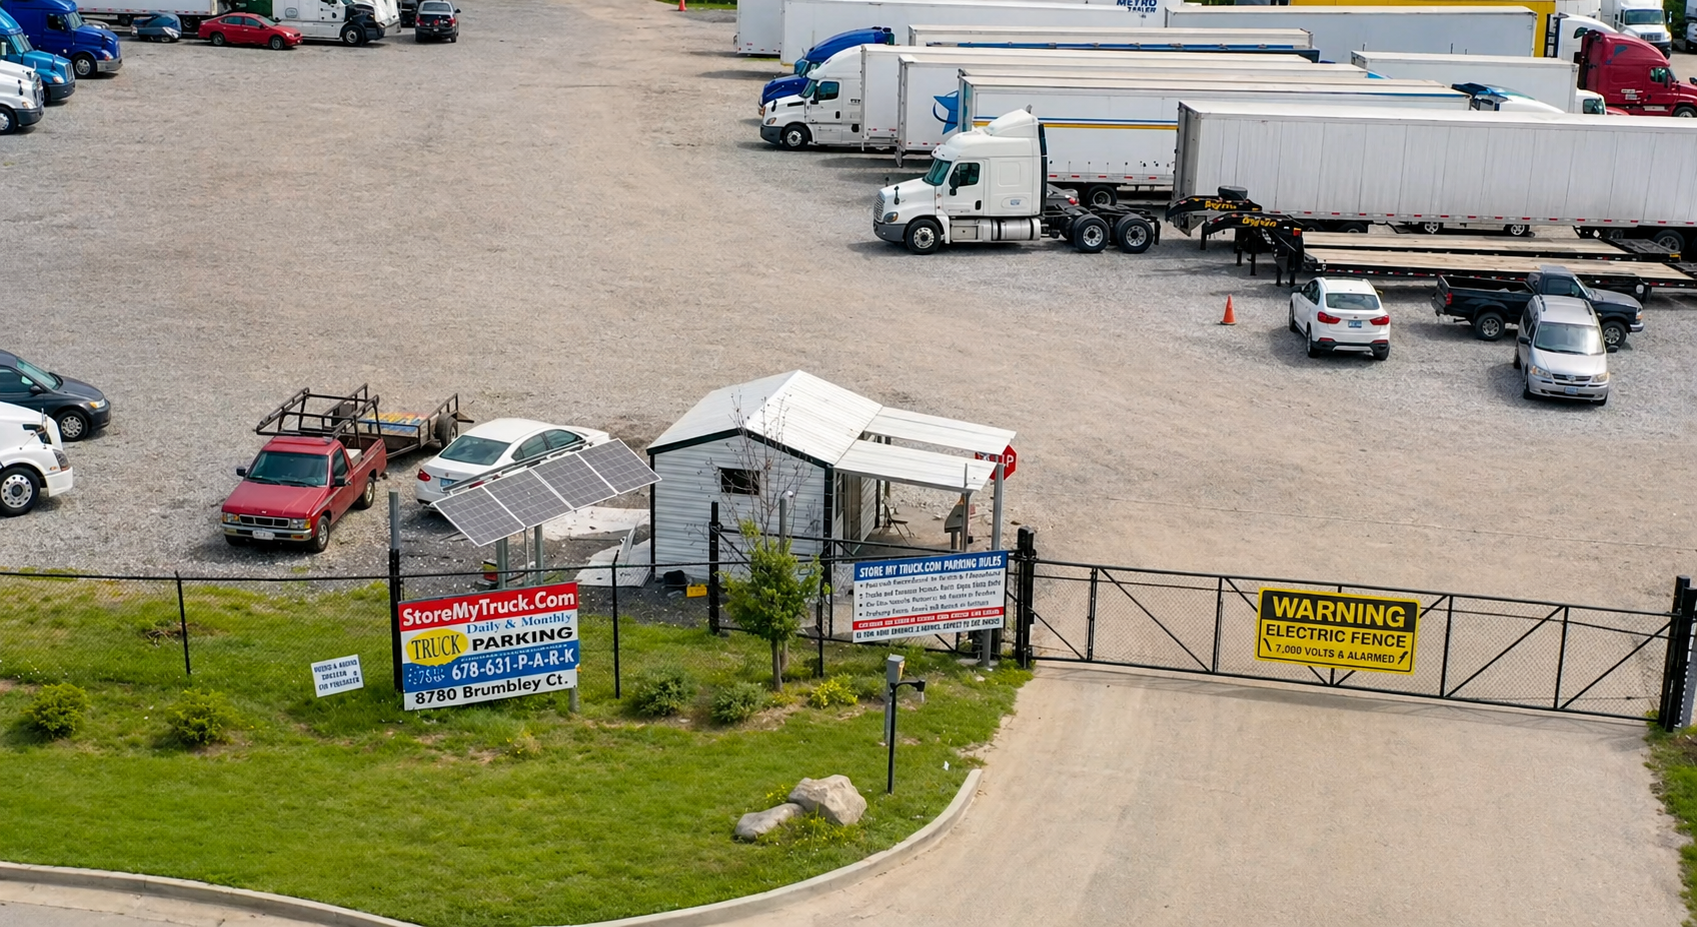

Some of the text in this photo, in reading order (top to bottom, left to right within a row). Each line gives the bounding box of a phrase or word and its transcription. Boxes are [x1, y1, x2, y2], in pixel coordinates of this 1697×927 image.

[859, 565, 883, 578] STORE
[885, 564, 898, 576] MY
[943, 557, 977, 571] PARKING
[402, 591, 575, 627] StoreMyTruck.Com
[1272, 595, 1406, 628] WARNING
[466, 612, 573, 635] Daily & Monthly
[1266, 623, 1407, 649] ELECTRIC FENCE
[411, 634, 462, 660] TRUCK
[472, 626, 573, 651] PARKING
[451, 648, 575, 681] 678-631-P-A-R-K
[1305, 647, 1335, 658] VOLTS
[1347, 651, 1395, 663] ALARMED
[415, 673, 569, 705] 8780 Brumbley Ct.
